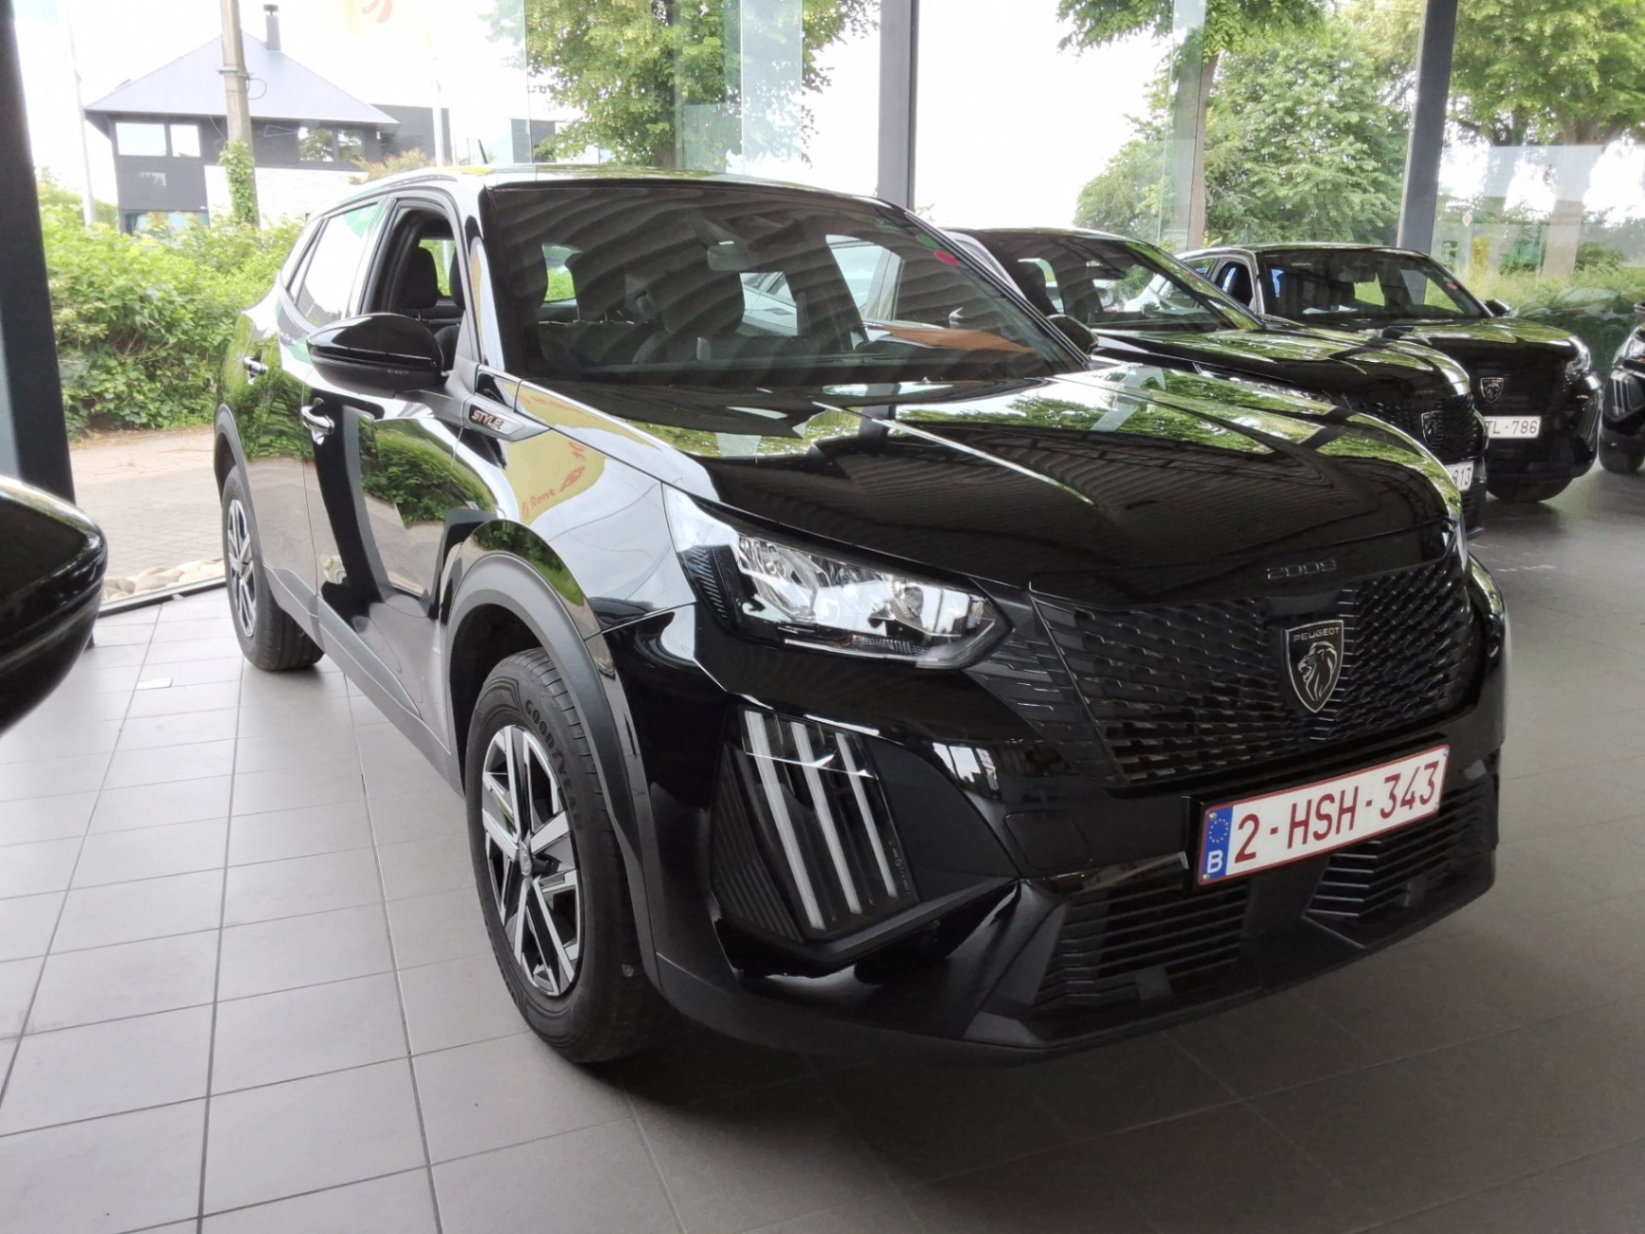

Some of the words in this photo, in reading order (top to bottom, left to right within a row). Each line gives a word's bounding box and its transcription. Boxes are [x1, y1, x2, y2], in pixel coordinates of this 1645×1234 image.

[471, 409, 504, 430] STYLE
[1293, 626, 1340, 642] PEUGEOT
[1234, 760, 1440, 864] 2-HSH-343
[1206, 850, 1224, 873] B
